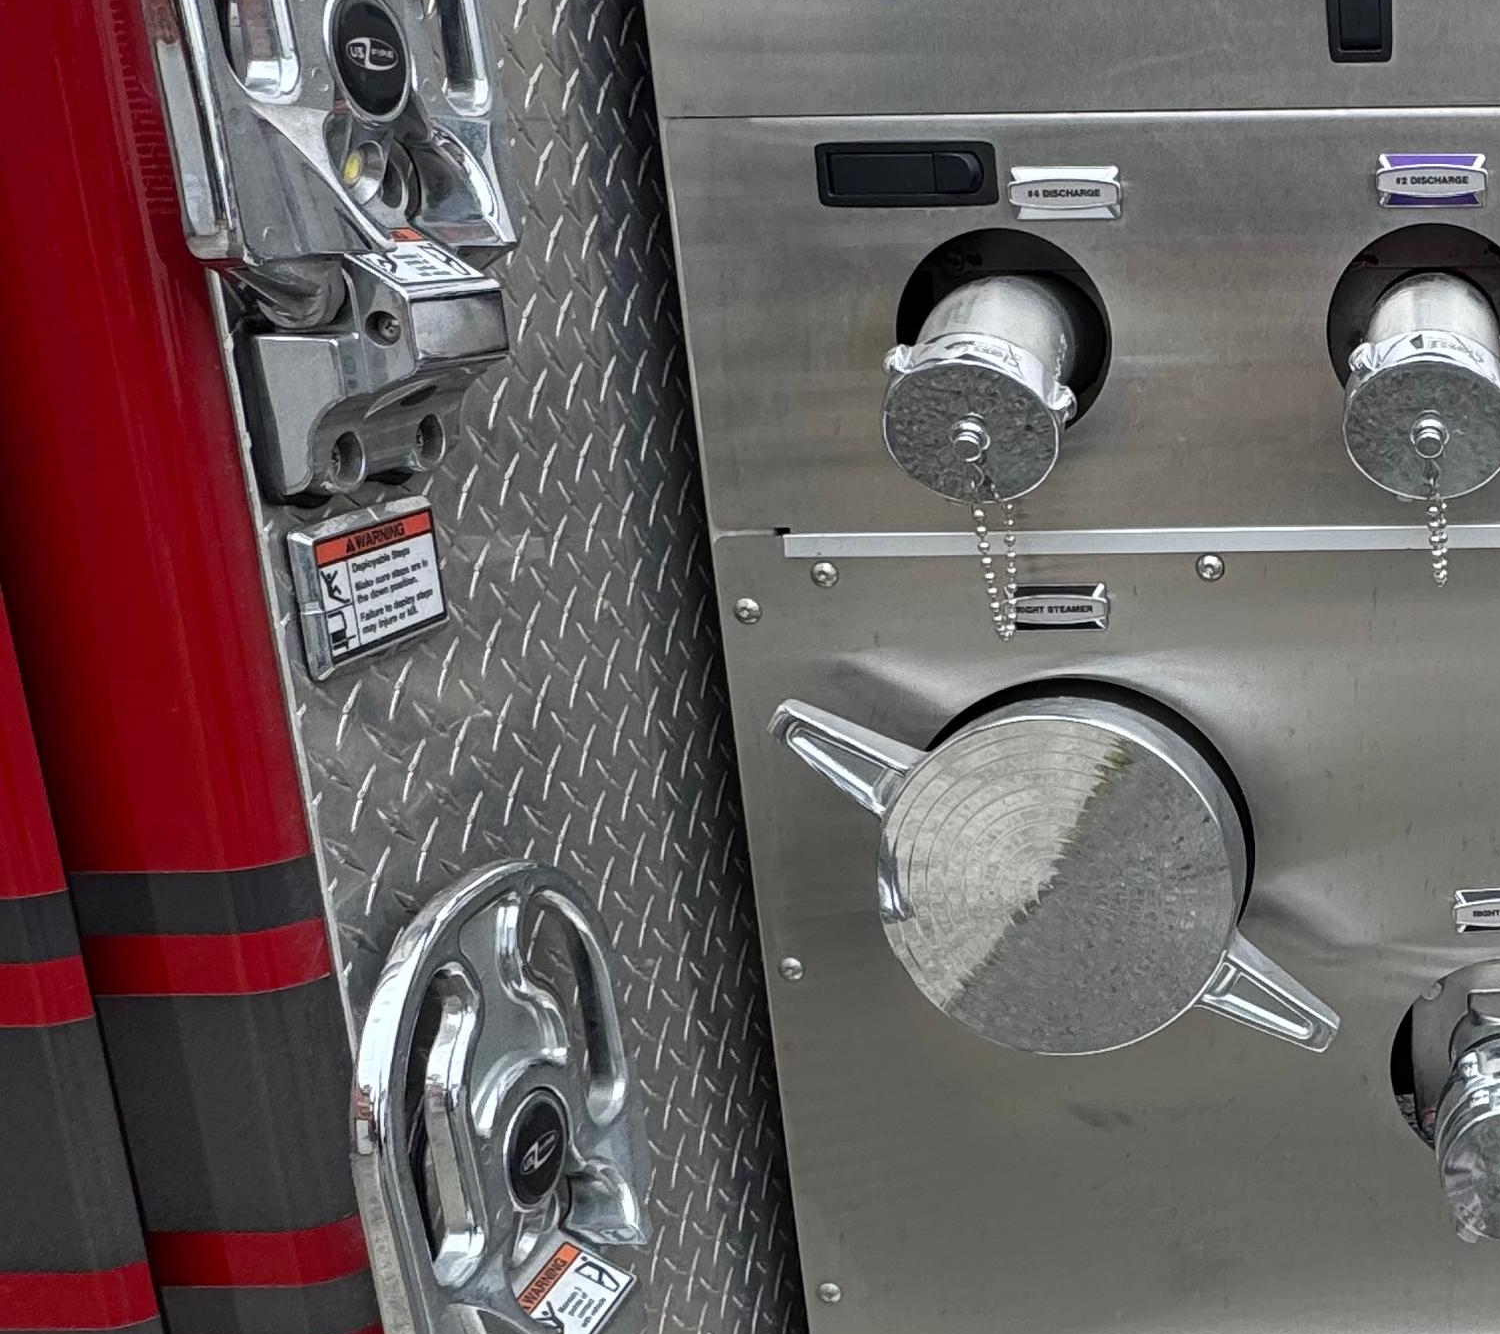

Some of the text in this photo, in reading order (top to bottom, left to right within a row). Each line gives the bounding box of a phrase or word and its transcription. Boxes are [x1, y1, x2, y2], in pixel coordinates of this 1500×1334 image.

[1410, 176, 1469, 185] DISCHARGE
[1042, 189, 1101, 198] DISCHARGE
[354, 523, 405, 548] WARNING
[1047, 605, 1093, 614] STEAMER
[1472, 909, 1500, 917] RIGHT
[521, 1256, 569, 1306] WARNING
